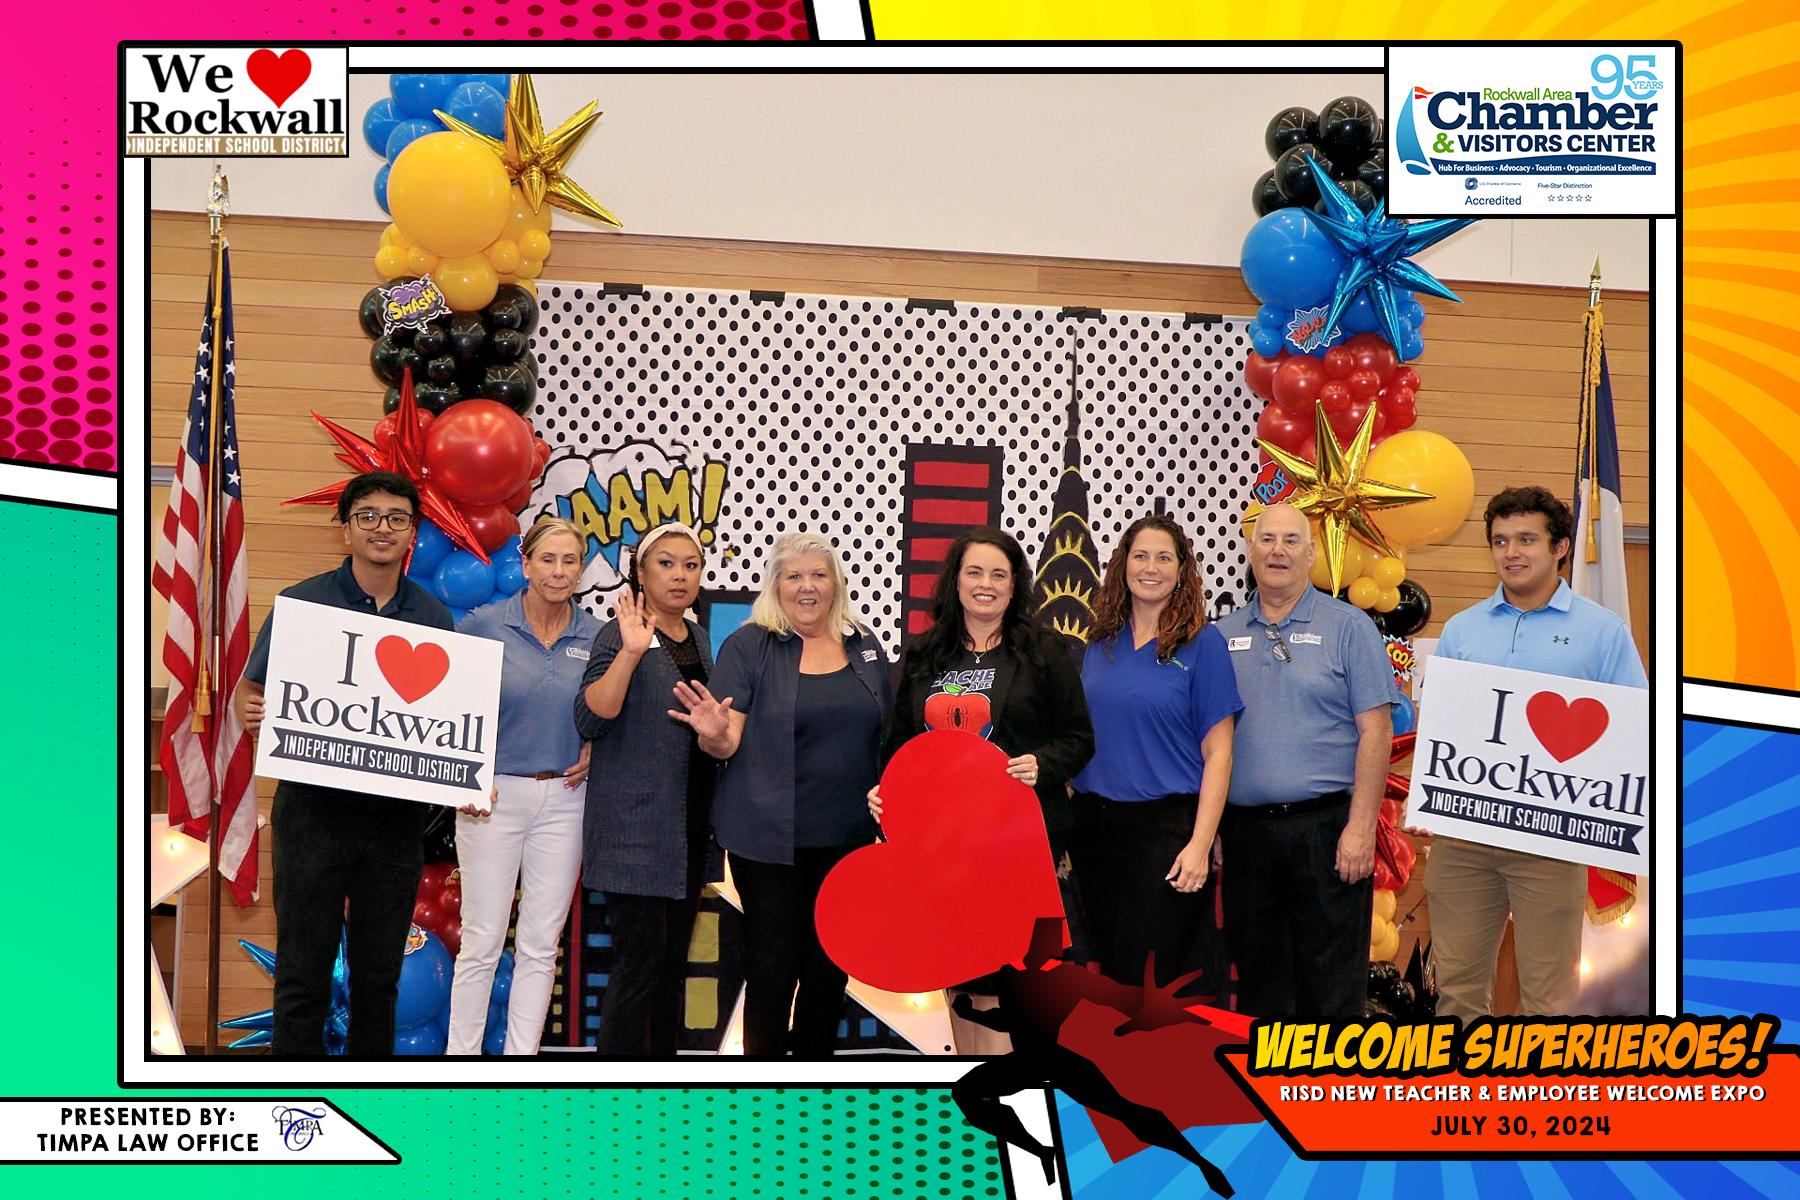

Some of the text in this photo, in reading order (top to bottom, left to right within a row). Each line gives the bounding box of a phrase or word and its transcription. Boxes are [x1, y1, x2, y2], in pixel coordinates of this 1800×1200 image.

[540, 462, 727, 546] AAM!
[337, 630, 363, 687] I
[275, 679, 485, 754] Rockwall
[1484, 688, 1514, 745] I
[283, 734, 469, 784] INDEPENDENT SCHOOL DISTRICT
[1424, 739, 1647, 817] Rockwall
[1430, 790, 1626, 846] INDEPENDENT SCHOOL DISTRICT
